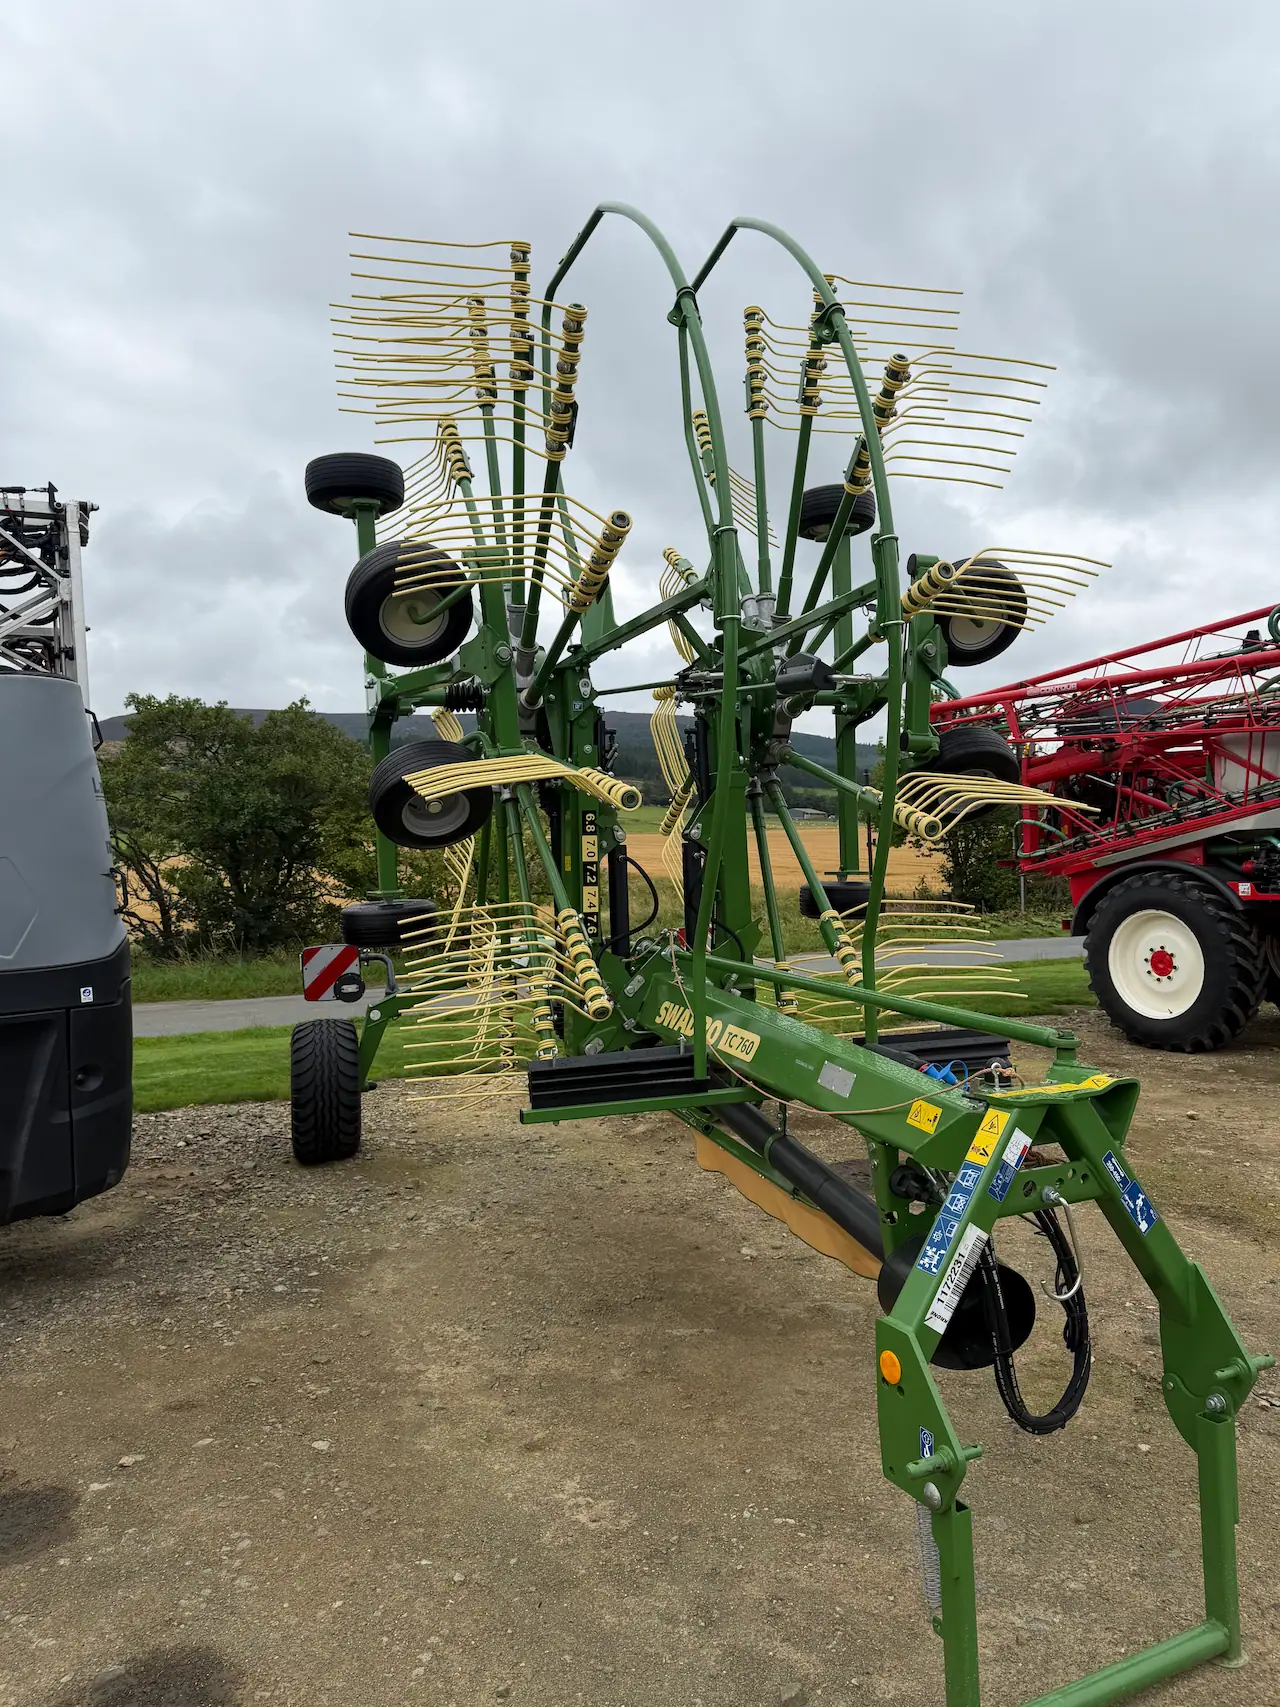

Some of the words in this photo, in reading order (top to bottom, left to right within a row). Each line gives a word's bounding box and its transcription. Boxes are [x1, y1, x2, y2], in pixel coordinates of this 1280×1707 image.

[585, 813, 596, 832] 6.8
[586, 840, 596, 858] 7.0
[586, 864, 597, 883] 7.2
[587, 891, 597, 909] 7.4
[587, 915, 597, 934] 7.6
[724, 1032, 738, 1048] TC
[735, 1036, 755, 1056] 760
[936, 1252, 966, 1305] 1172231
[930, 1310, 948, 1324] KRONE
